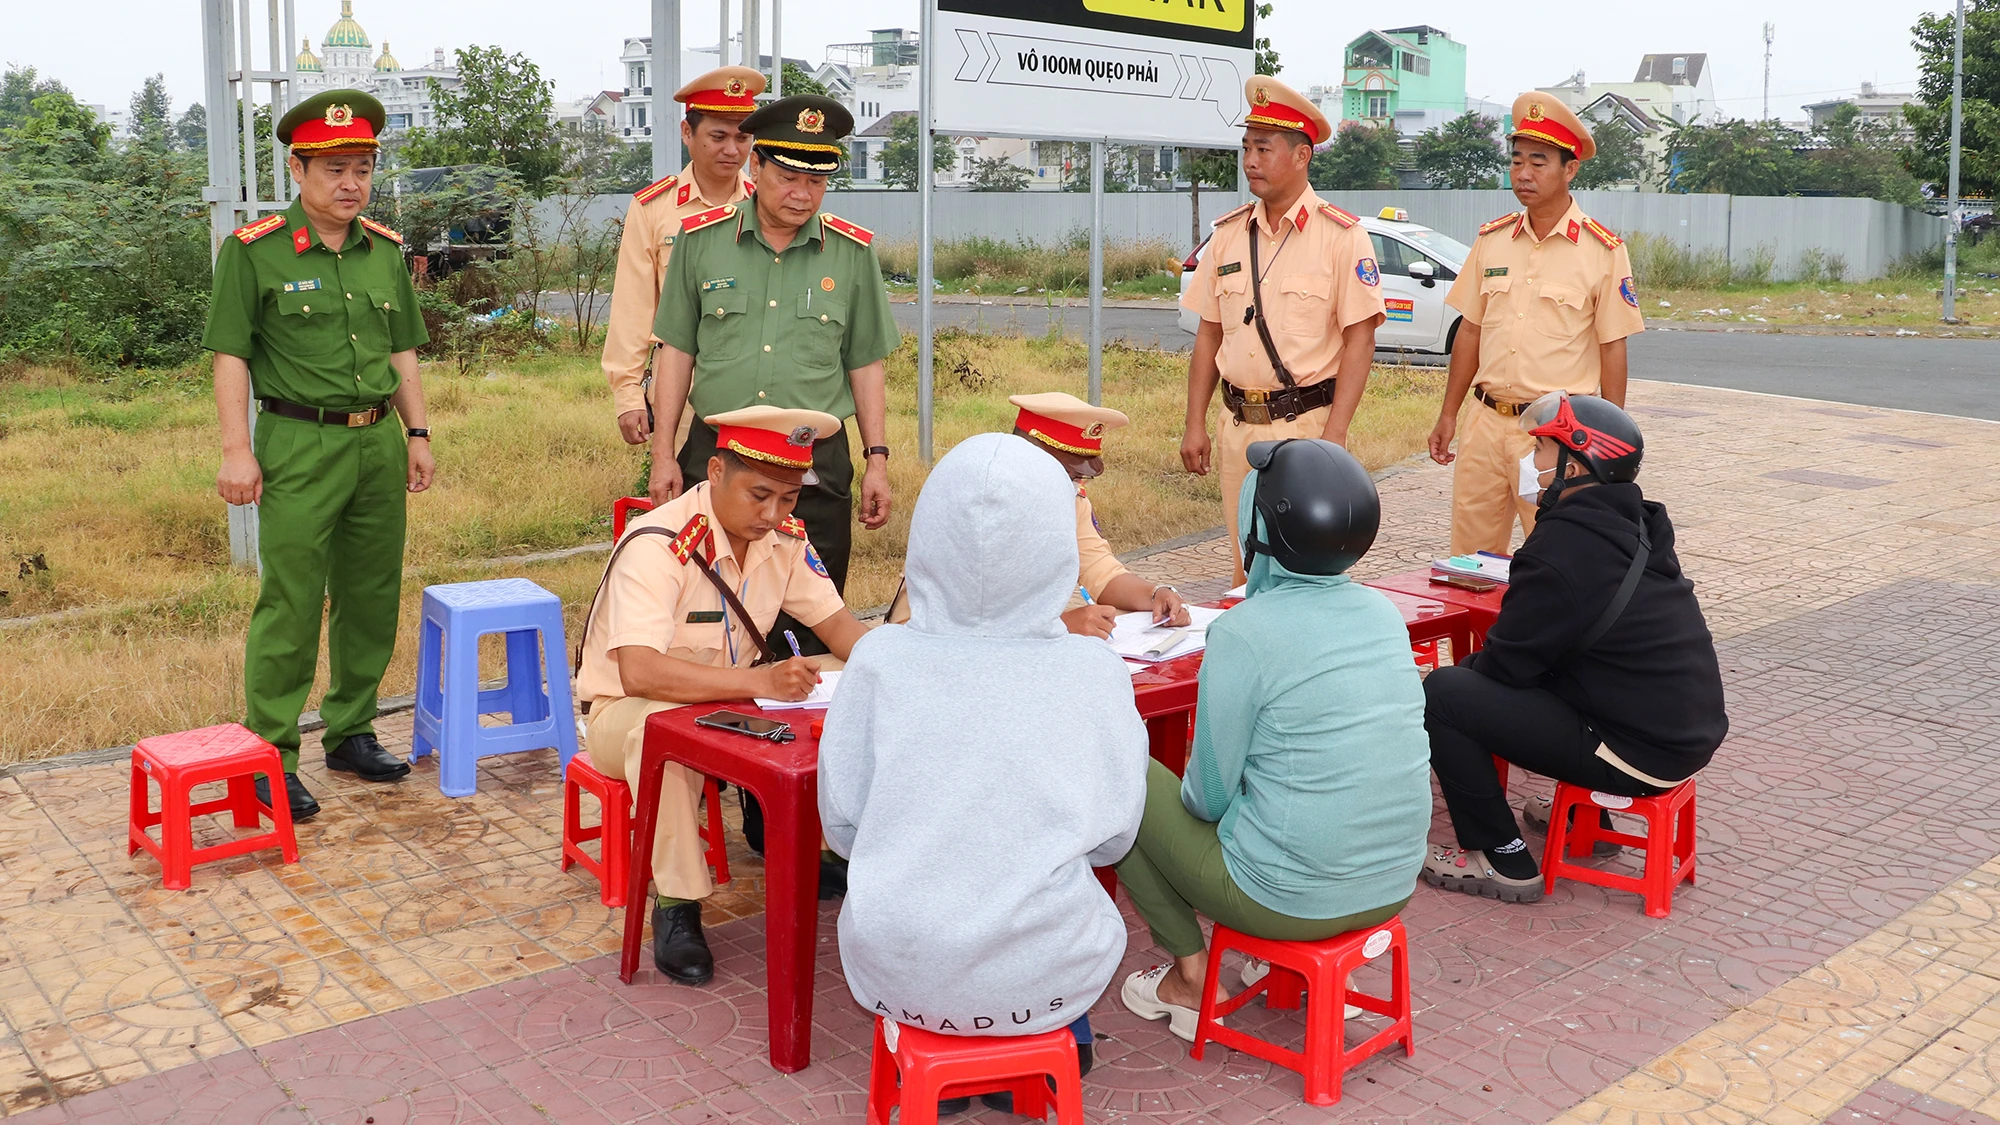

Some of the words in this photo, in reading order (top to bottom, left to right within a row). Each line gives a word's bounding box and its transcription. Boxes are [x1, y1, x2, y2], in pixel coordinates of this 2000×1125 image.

[1017, 47, 1039, 72] VÔ
[1042, 54, 1082, 76] 100M
[1085, 59, 1124, 84] QUẸO
[1127, 60, 1159, 83] PHẢI
[875, 997, 1064, 1032] AMADUS
